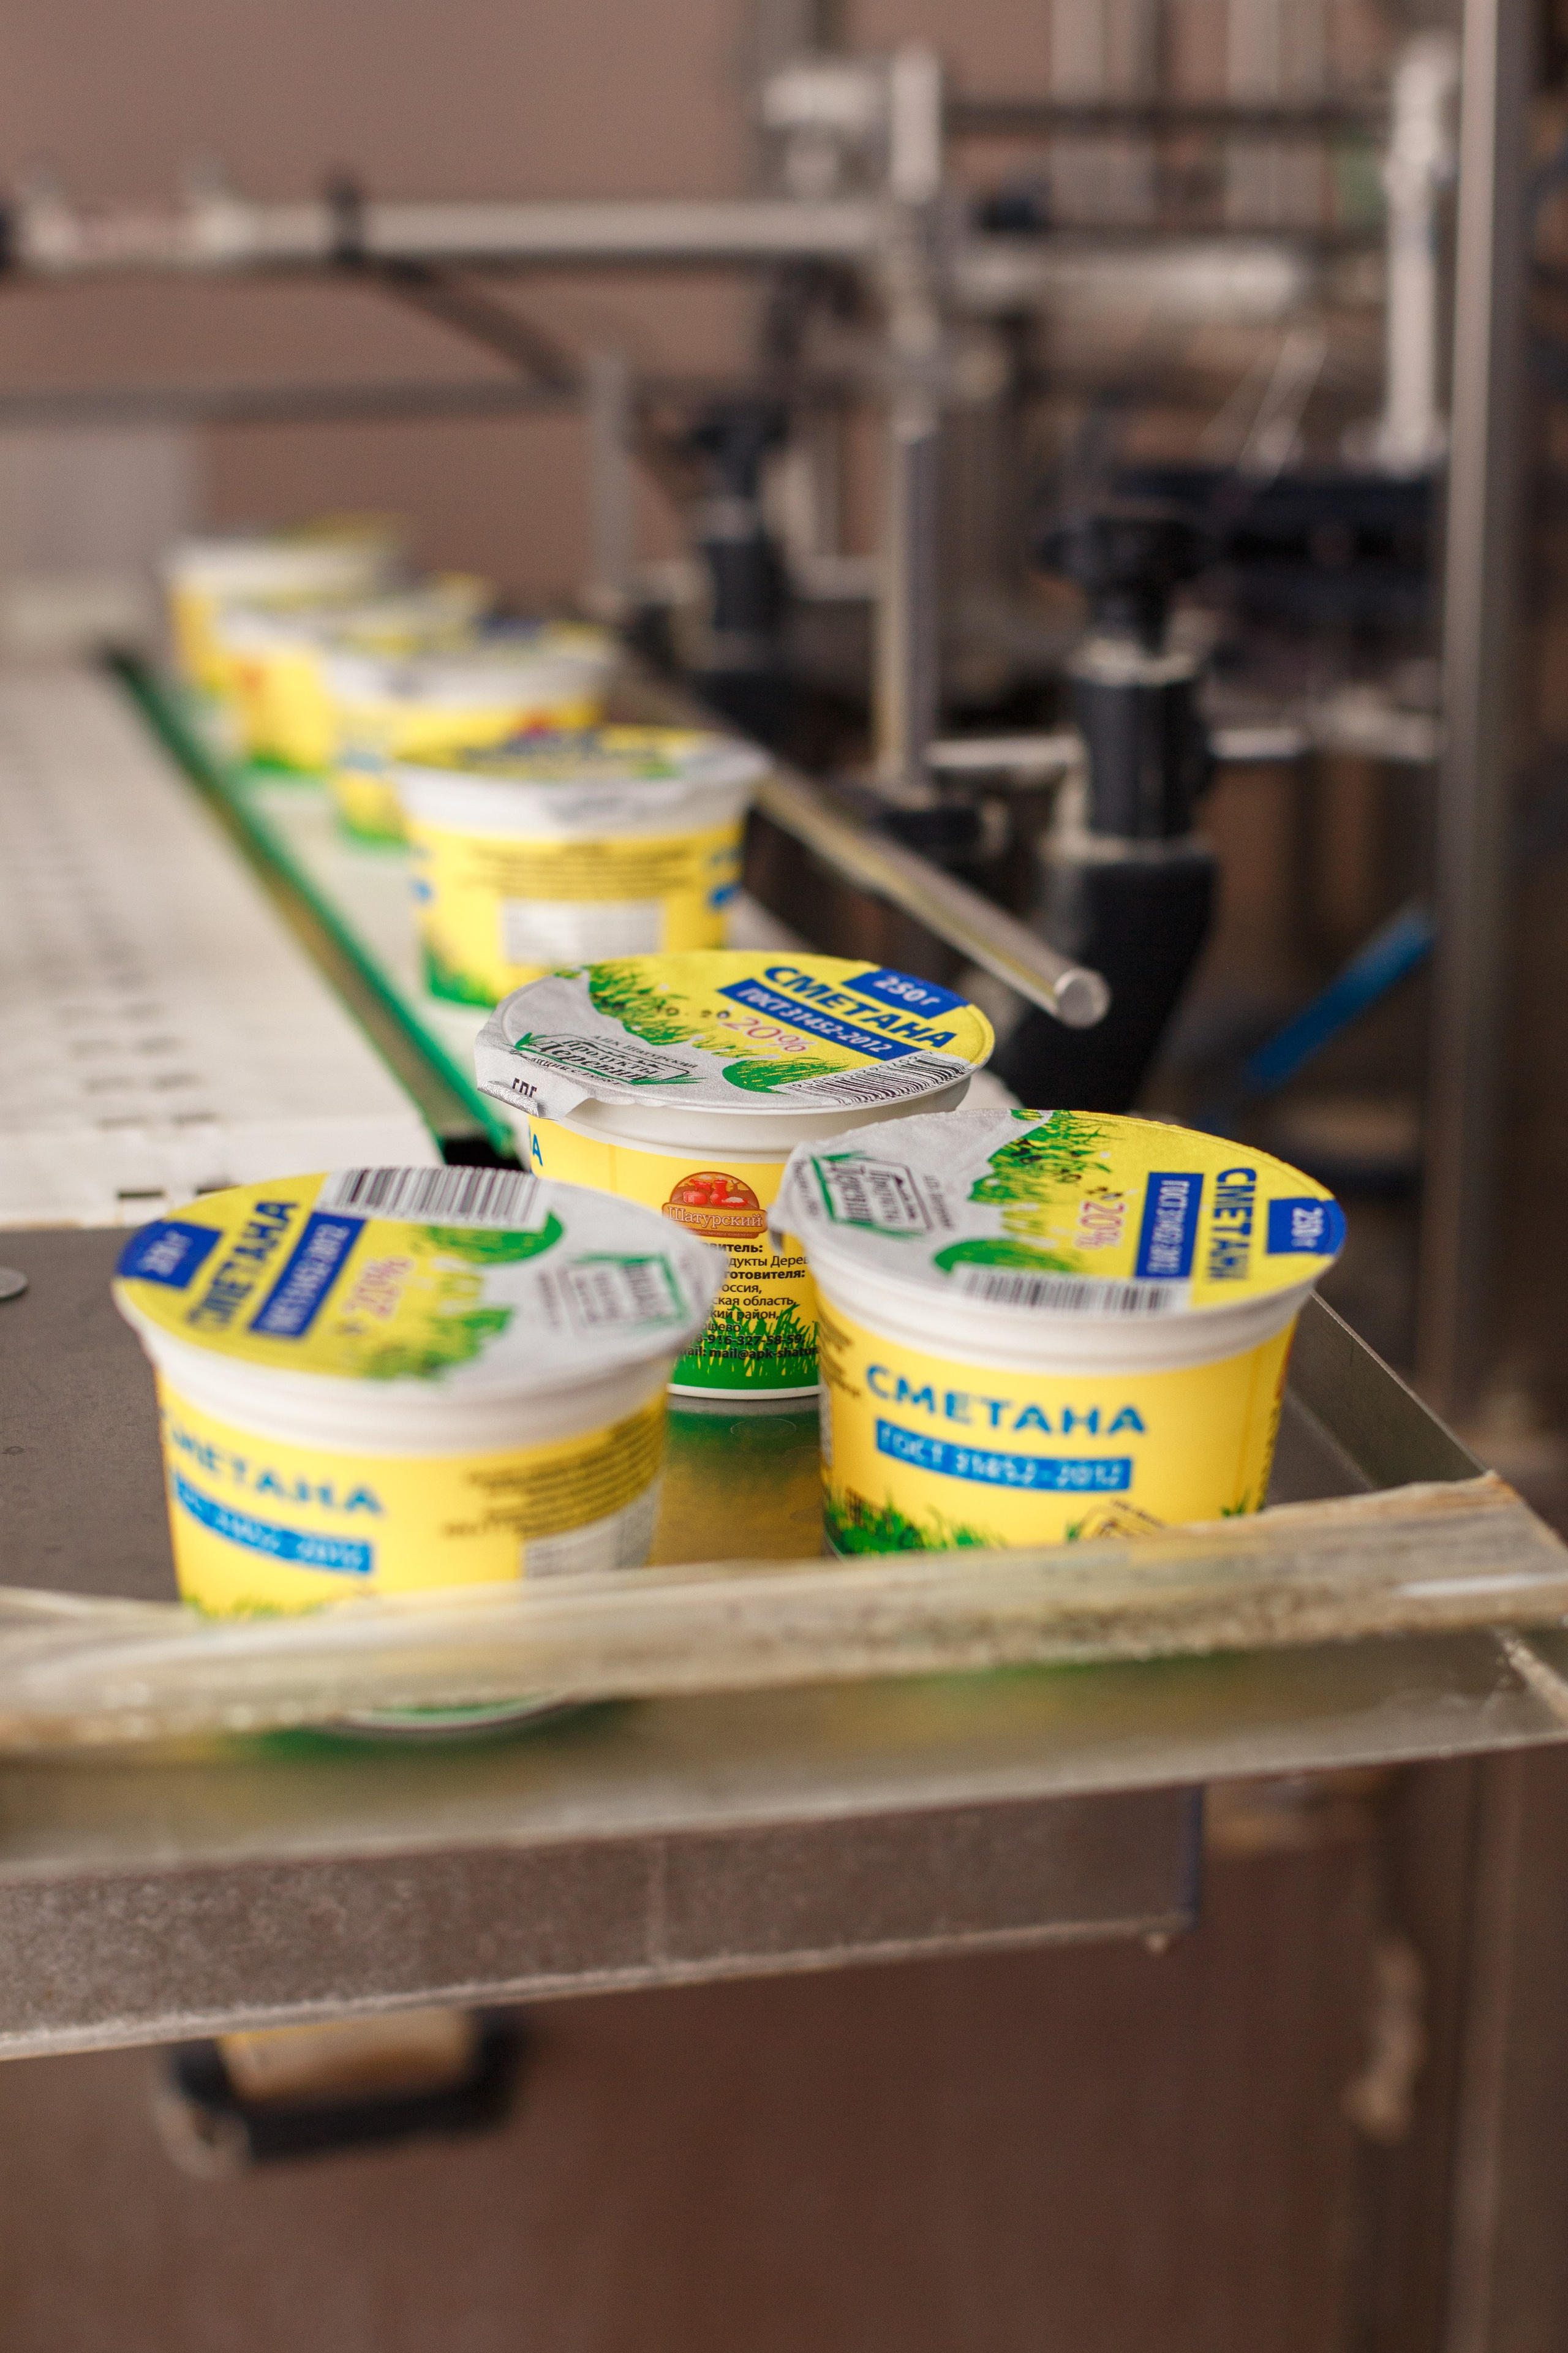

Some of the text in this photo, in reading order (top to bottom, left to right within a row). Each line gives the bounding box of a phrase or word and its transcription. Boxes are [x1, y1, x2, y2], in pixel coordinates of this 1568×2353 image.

[736, 987, 894, 1054] ГОСТ 31452-2012
[764, 966, 957, 1048] СМЕТАНА
[720, 1017, 816, 1052] 20%
[528, 1041, 650, 1081] Деревни
[562, 1040, 662, 1076] Продукты
[622, 1044, 699, 1068] Шатурский
[668, 1207, 763, 1228] Шатурский
[704, 1242, 763, 1253] витель:
[737, 1309, 779, 1321] район,
[743, 1295, 797, 1306] область,
[866, 1364, 1145, 1437] СМЕТАНА
[163, 1415, 384, 1516] МЕТАНА
